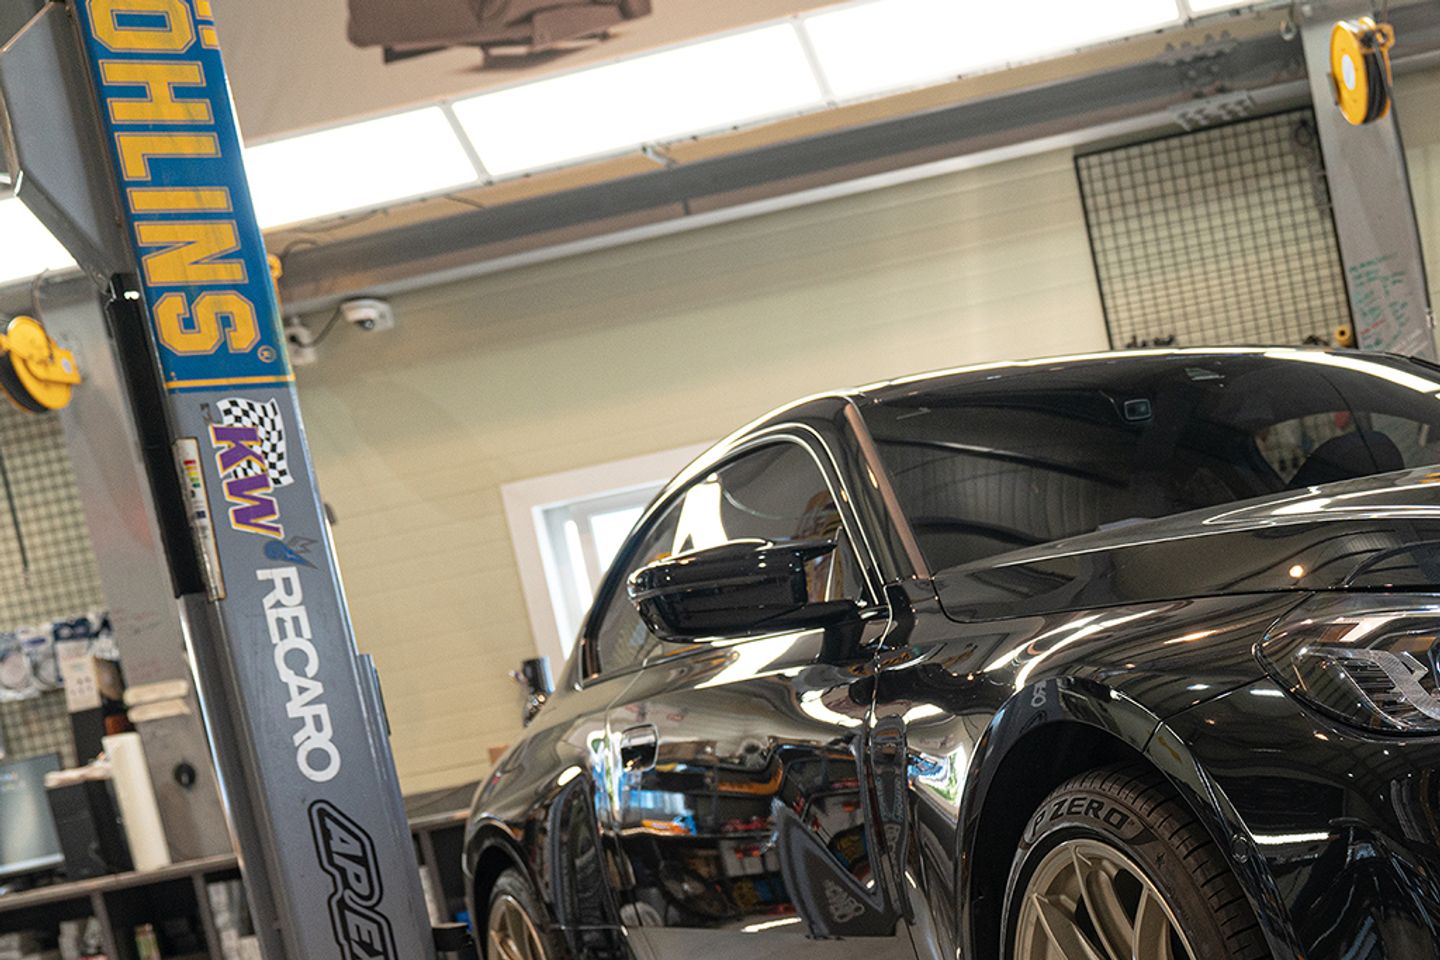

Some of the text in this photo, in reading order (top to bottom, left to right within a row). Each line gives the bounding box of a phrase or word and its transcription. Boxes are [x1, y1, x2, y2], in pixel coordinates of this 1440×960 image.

[208, 424, 285, 538] KW
[256, 566, 341, 783] RECARO
[1050, 797, 1130, 830] ZERO
